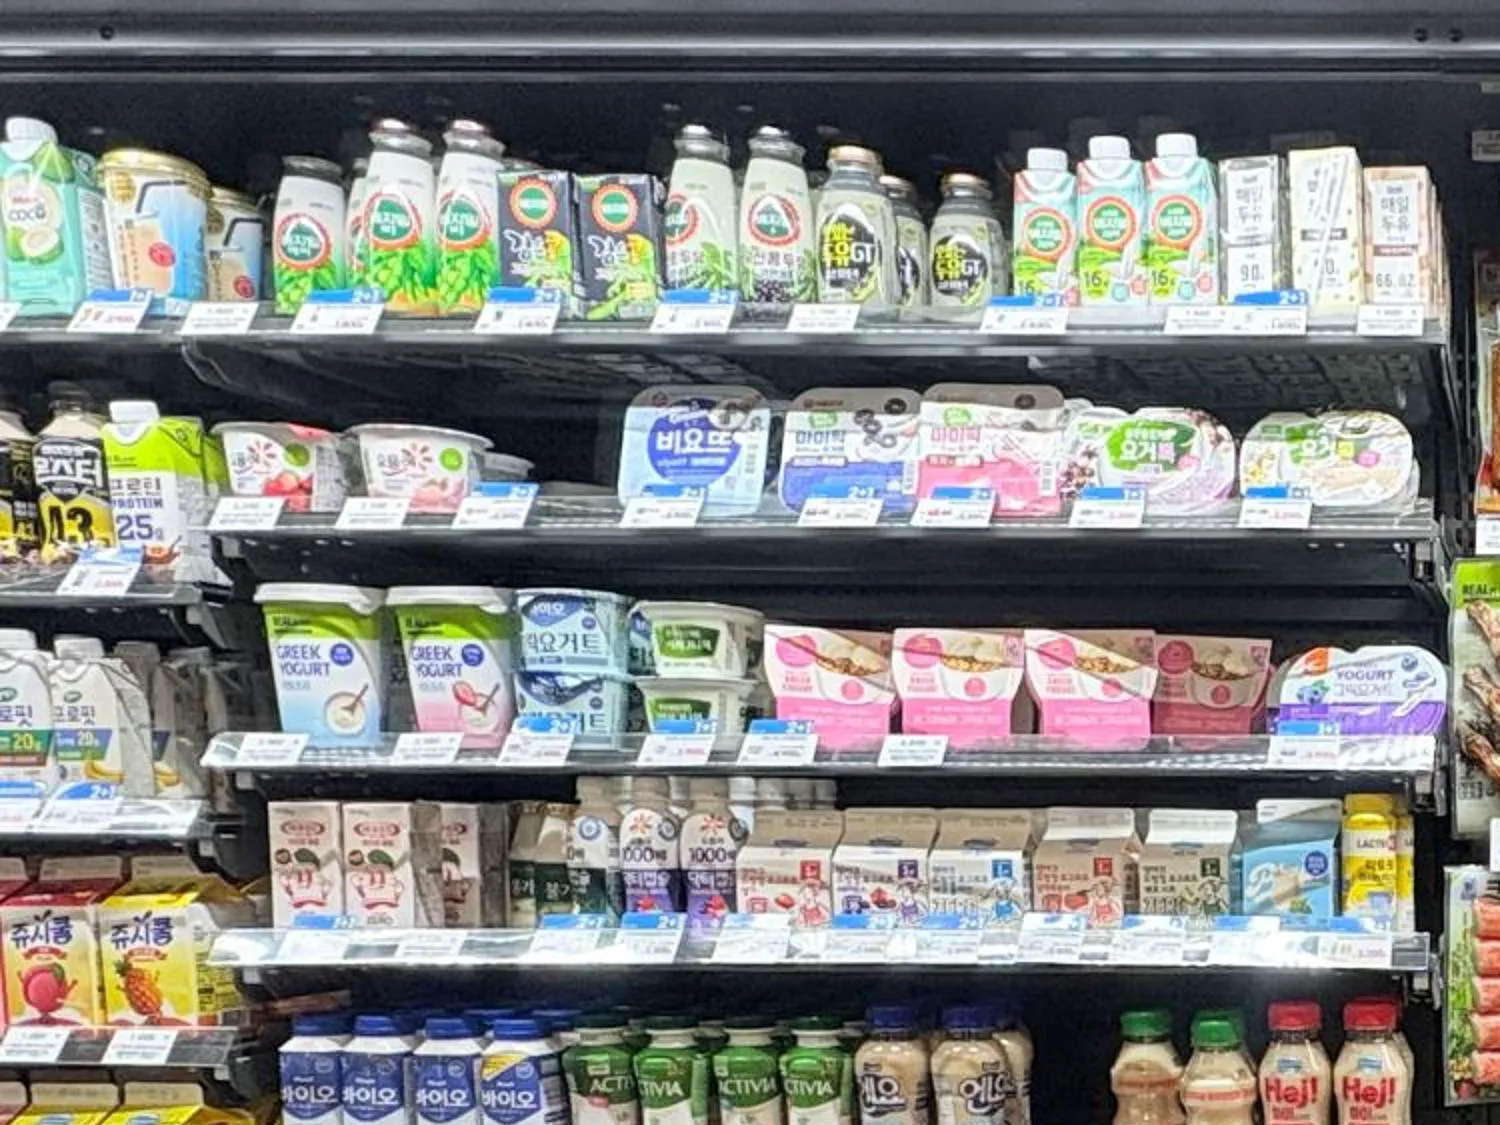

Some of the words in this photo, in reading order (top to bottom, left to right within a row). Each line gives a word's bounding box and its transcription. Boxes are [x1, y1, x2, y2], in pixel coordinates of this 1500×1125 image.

[656, 429, 734, 454] 비요뜨
[276, 644, 322, 662] GREEK
[411, 644, 455, 662] GREEK
[279, 661, 331, 678] YOGURT
[414, 661, 464, 679] YOGURT
[1336, 668, 1395, 682] YOGURT
[10, 915, 74, 947] 쥬시쿨
[110, 915, 174, 947] 쥬시쿨
[1264, 1076, 1320, 1108] Hej!
[1342, 1076, 1397, 1108] Hej!
